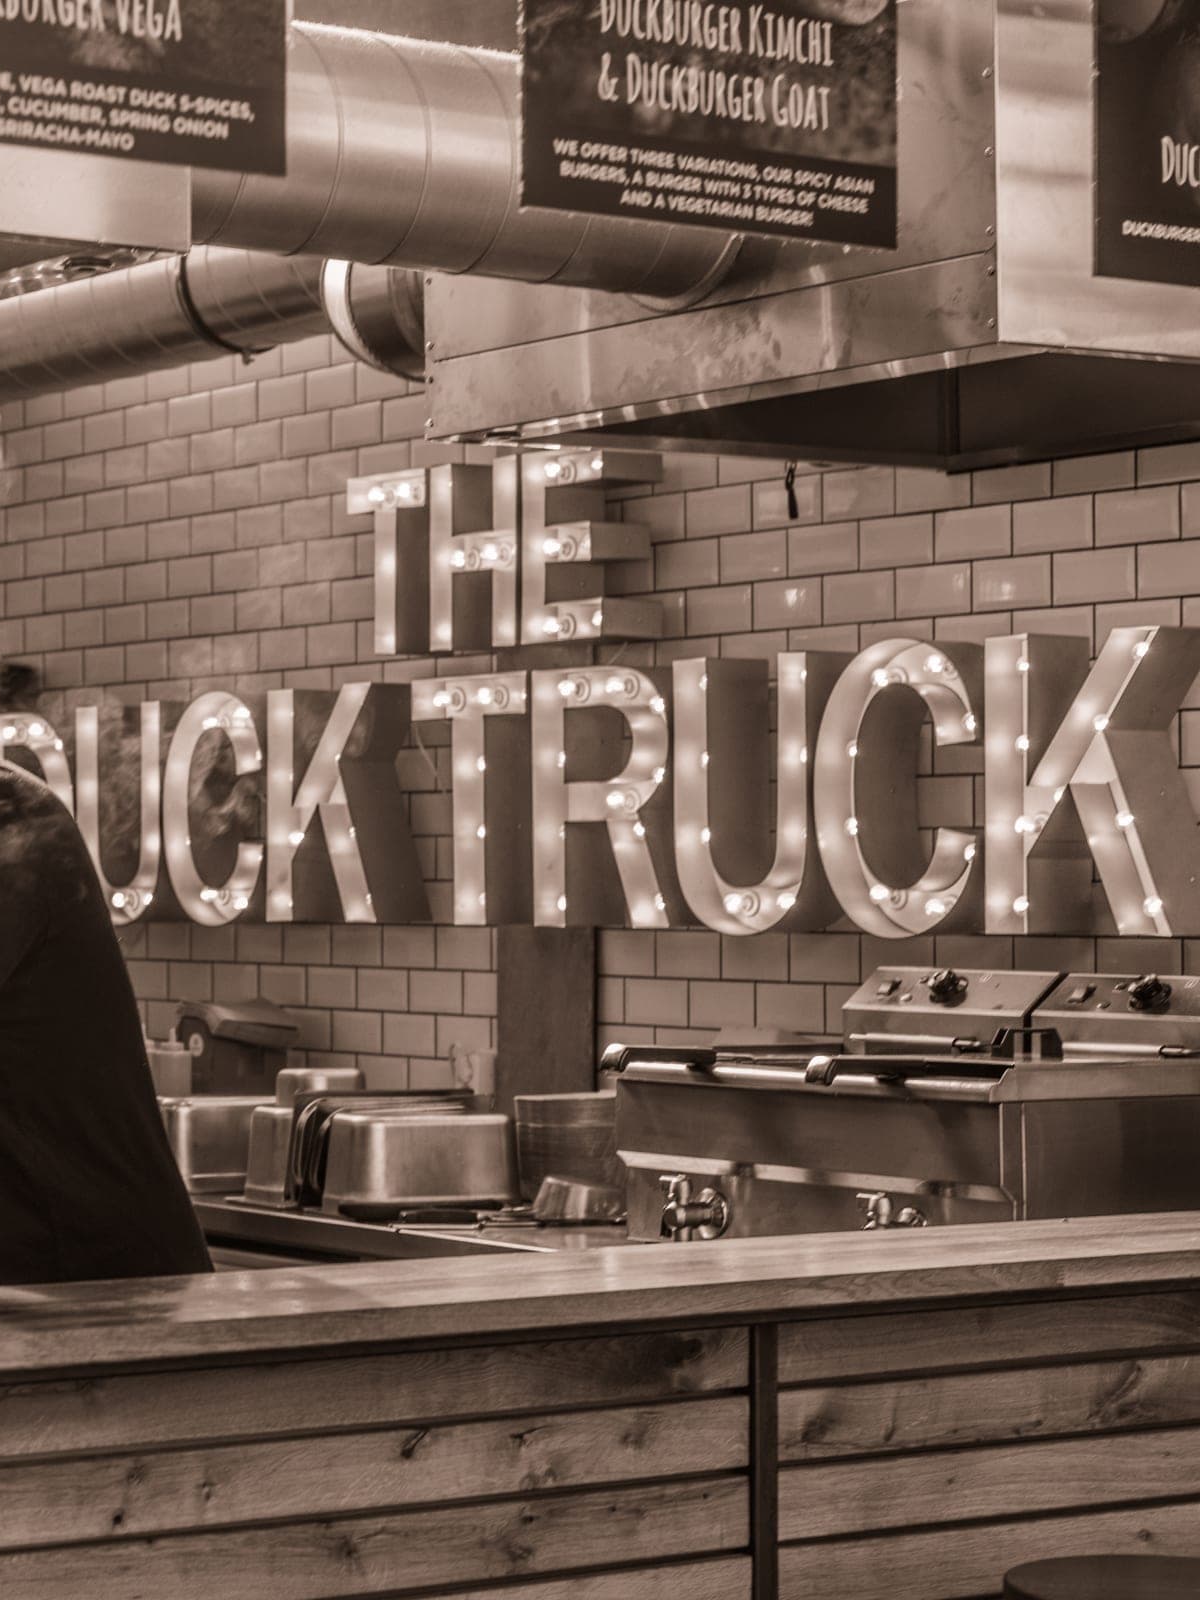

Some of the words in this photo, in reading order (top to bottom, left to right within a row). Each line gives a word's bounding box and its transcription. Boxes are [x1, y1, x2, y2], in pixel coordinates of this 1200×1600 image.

[116, 0, 182, 42] VEGA
[600, 0, 743, 54] DUCKBURGER
[749, 4, 834, 67] KIMCHI
[7, 95, 107, 127] CUCUMBER,
[109, 108, 171, 133] SPRING
[173, 116, 230, 140] ONION
[19, 74, 68, 97] VEGA
[70, 80, 127, 104] ROAST
[129, 88, 177, 110] DUCK
[598, 51, 619, 101] &
[626, 52, 766, 124] DUCKBURGER
[771, 72, 831, 131] GOAT
[553, 137, 579, 157] WE
[580, 142, 628, 162] OFFER
[630, 148, 676, 169] THREE
[676, 154, 761, 182] VARIATIONS,
[762, 165, 794, 184] OUR
[794, 169, 833, 189] SPICY
[833, 174, 875, 195] ASIAN
[560, 160, 631, 187] BURGERS,
[631, 169, 644, 185] A
[645, 171, 702, 193] BURGER
[703, 178, 741, 198] WITH
[742, 183, 752, 199] 3
[753, 183, 795, 205] TYPES
[796, 190, 818, 207] OF
[818, 193, 869, 215] CHEESE
[620, 189, 652, 208] AND
[654, 192, 666, 209] A
[667, 194, 754, 220] VEGETARIAN
[347, 451, 603, 655] THE
[411, 626, 1172, 938] TRUCK
